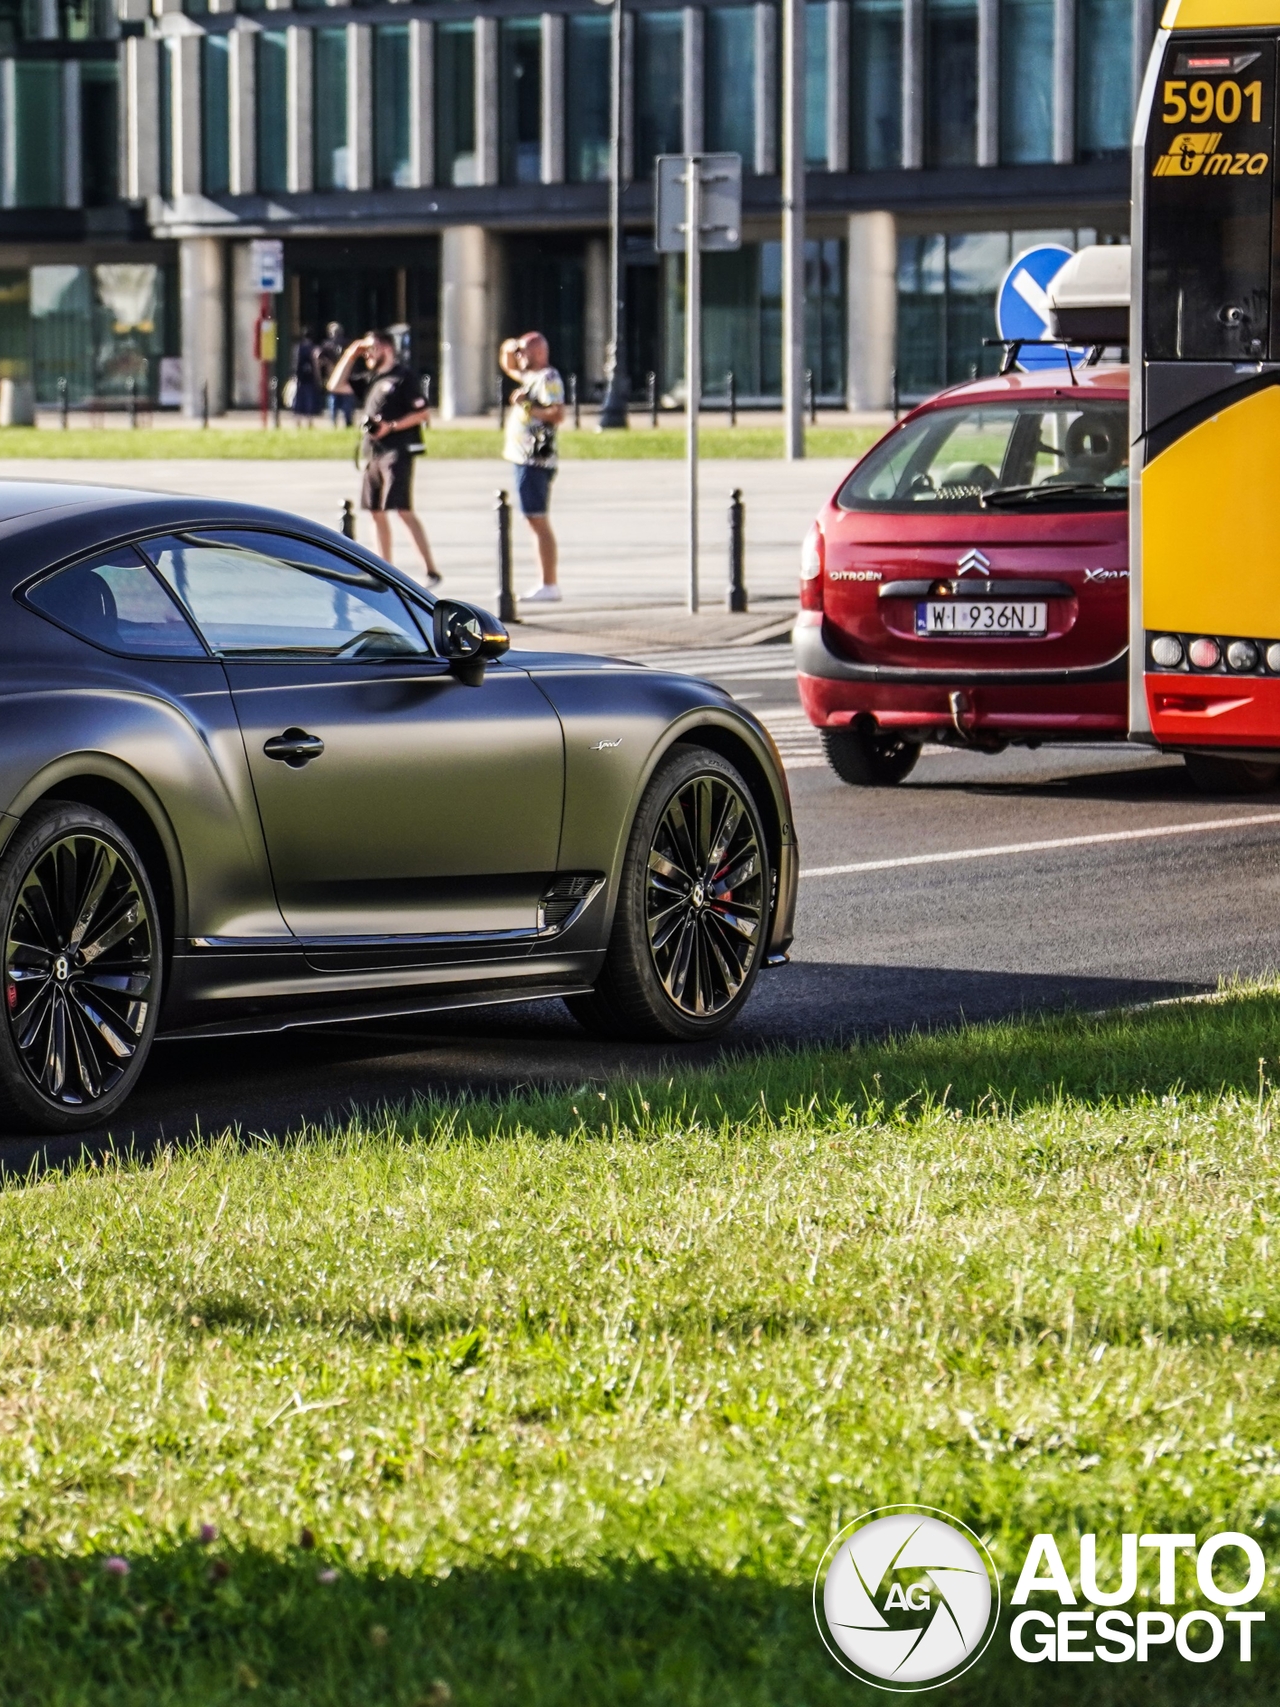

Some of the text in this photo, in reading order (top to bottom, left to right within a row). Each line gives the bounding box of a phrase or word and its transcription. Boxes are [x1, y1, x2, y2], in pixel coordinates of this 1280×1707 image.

[1162, 80, 1263, 125] 5901
[1202, 152, 1270, 176] mza
[829, 570, 883, 582] CITROËN
[932, 605, 1038, 629] WI 936NJ
